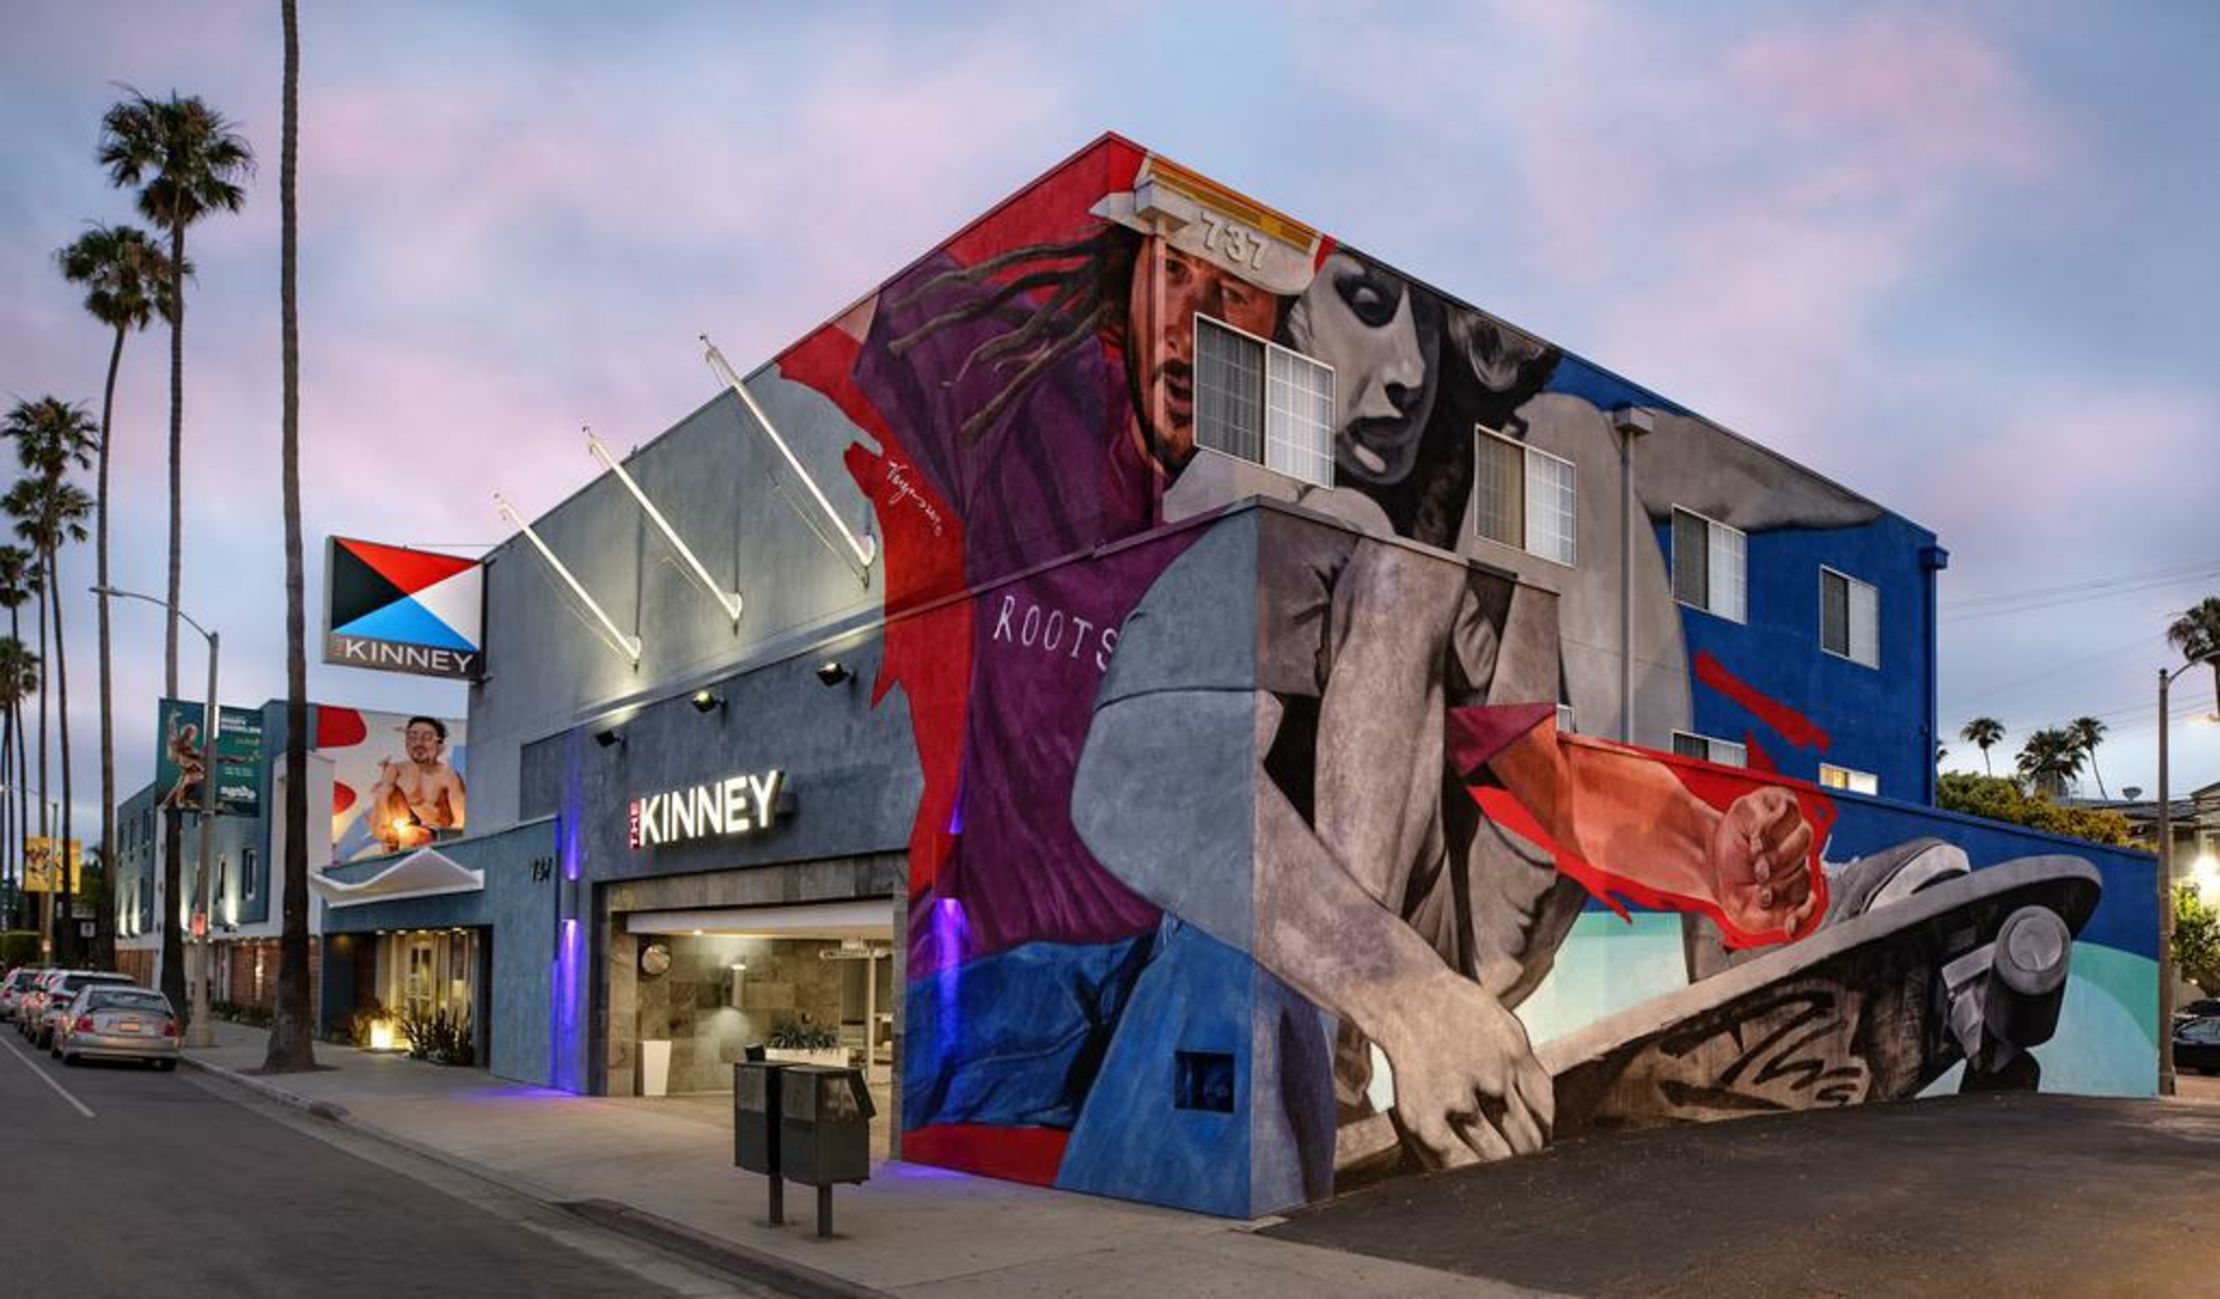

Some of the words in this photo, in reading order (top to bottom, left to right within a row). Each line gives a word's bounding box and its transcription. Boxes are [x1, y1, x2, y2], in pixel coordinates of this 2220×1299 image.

[1200, 211, 1269, 272] 737
[345, 639, 473, 672] KINNEY
[993, 595, 1118, 672] ROOTS
[639, 769, 779, 847] KINNEY
